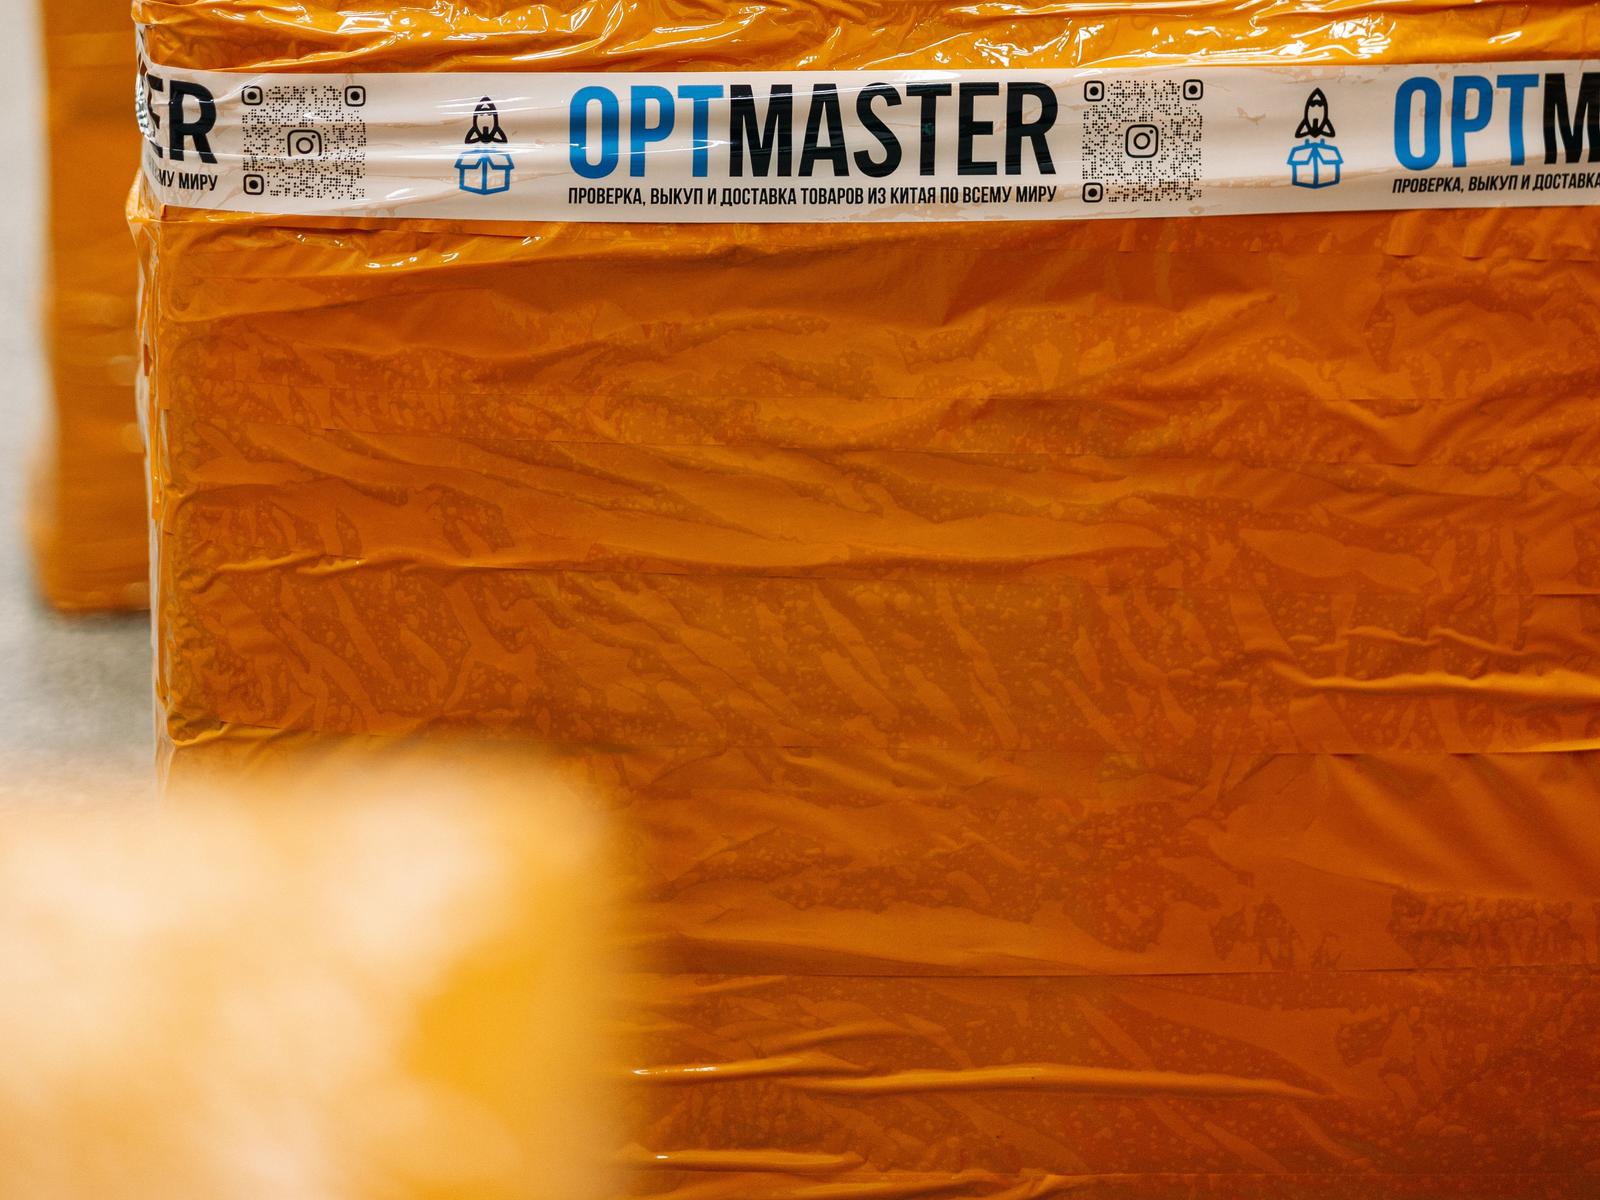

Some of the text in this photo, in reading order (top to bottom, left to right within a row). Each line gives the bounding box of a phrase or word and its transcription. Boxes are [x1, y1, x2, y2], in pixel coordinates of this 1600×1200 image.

[146, 74, 218, 164] ER
[569, 82, 1058, 179] OPTMASTER
[1394, 72, 1600, 171] OPTM
[178, 172, 218, 191] МИРУ
[568, 185, 1057, 206] ПРОВЕРКА, ВЫКУП И ДОСТАВКА ТОВАРОВ ИЗ КИТАЯ ПО ВСЕМУ МИРУ
[1392, 176, 1464, 194] ПРОВЕРКА,
[1468, 175, 1518, 191] ВЫКУП
[1521, 174, 1531, 190] И
